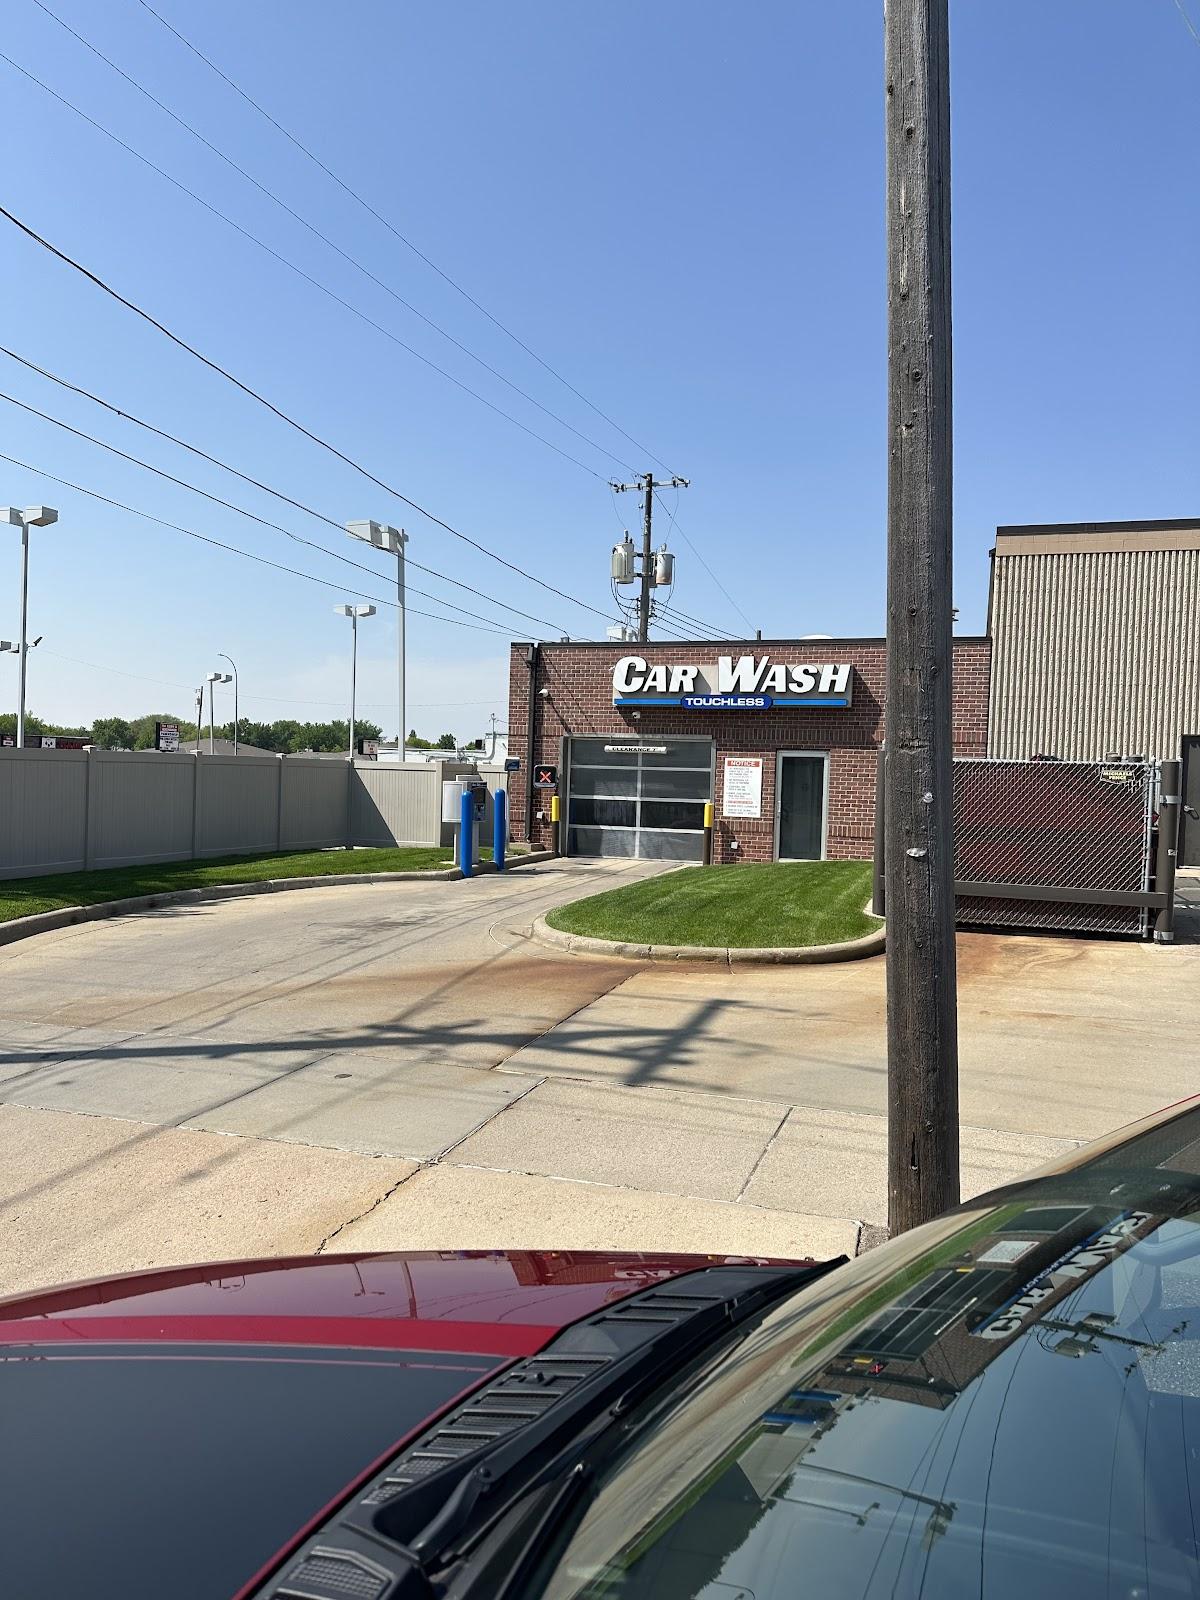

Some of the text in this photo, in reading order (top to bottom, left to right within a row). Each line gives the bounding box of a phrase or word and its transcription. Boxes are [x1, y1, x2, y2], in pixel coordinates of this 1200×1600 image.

[613, 656, 850, 692] CAR WASH
[685, 697, 765, 707] TOUCHLESS
